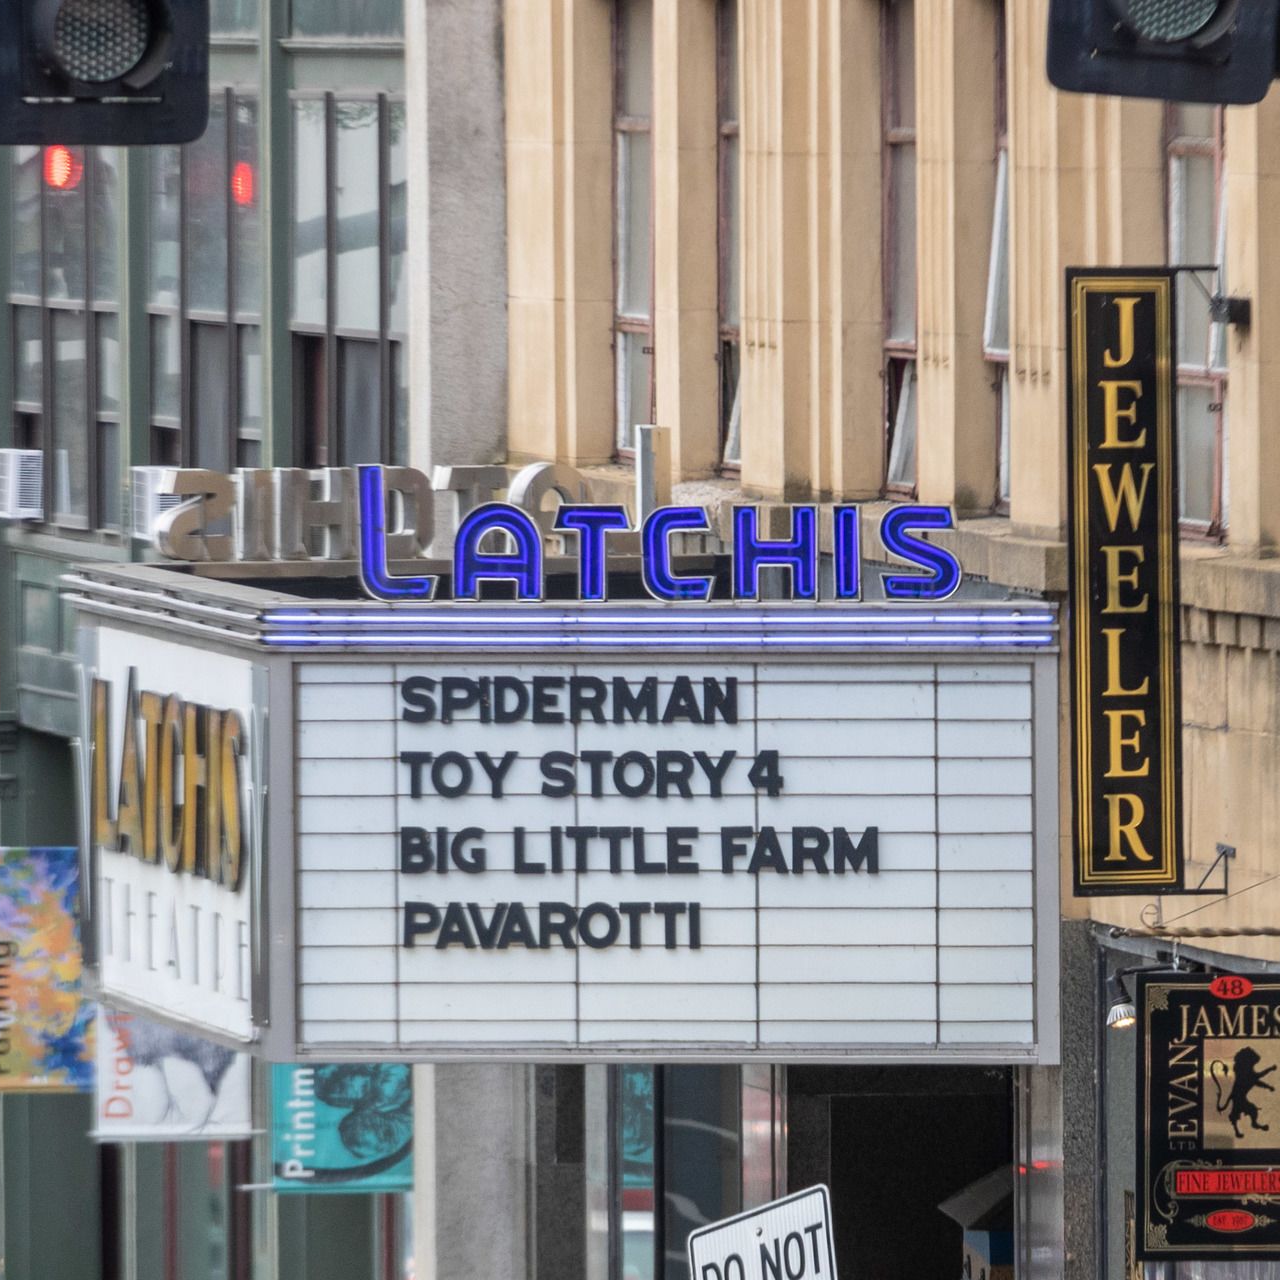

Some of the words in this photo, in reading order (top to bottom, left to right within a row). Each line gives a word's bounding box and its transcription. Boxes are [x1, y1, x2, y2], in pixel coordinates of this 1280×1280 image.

[356, 464, 963, 602] LATCHIS
[1093, 297, 1155, 861] JEWELER
[401, 675, 738, 724] SPIDERMAN
[92, 666, 247, 893] LATCHIS
[400, 751, 518, 799] TOY
[540, 750, 736, 799] STORY
[748, 750, 784, 798] 4
[401, 826, 487, 875] BIG
[514, 826, 699, 875] LITTLE
[721, 826, 878, 875] FARM
[402, 901, 701, 950] PAVAROTTI
[1216, 978, 1245, 997] 48
[1168, 1041, 1198, 1139] EVAN
[283, 1067, 316, 1178] Printm
[1177, 1171, 1210, 1193] FINE
